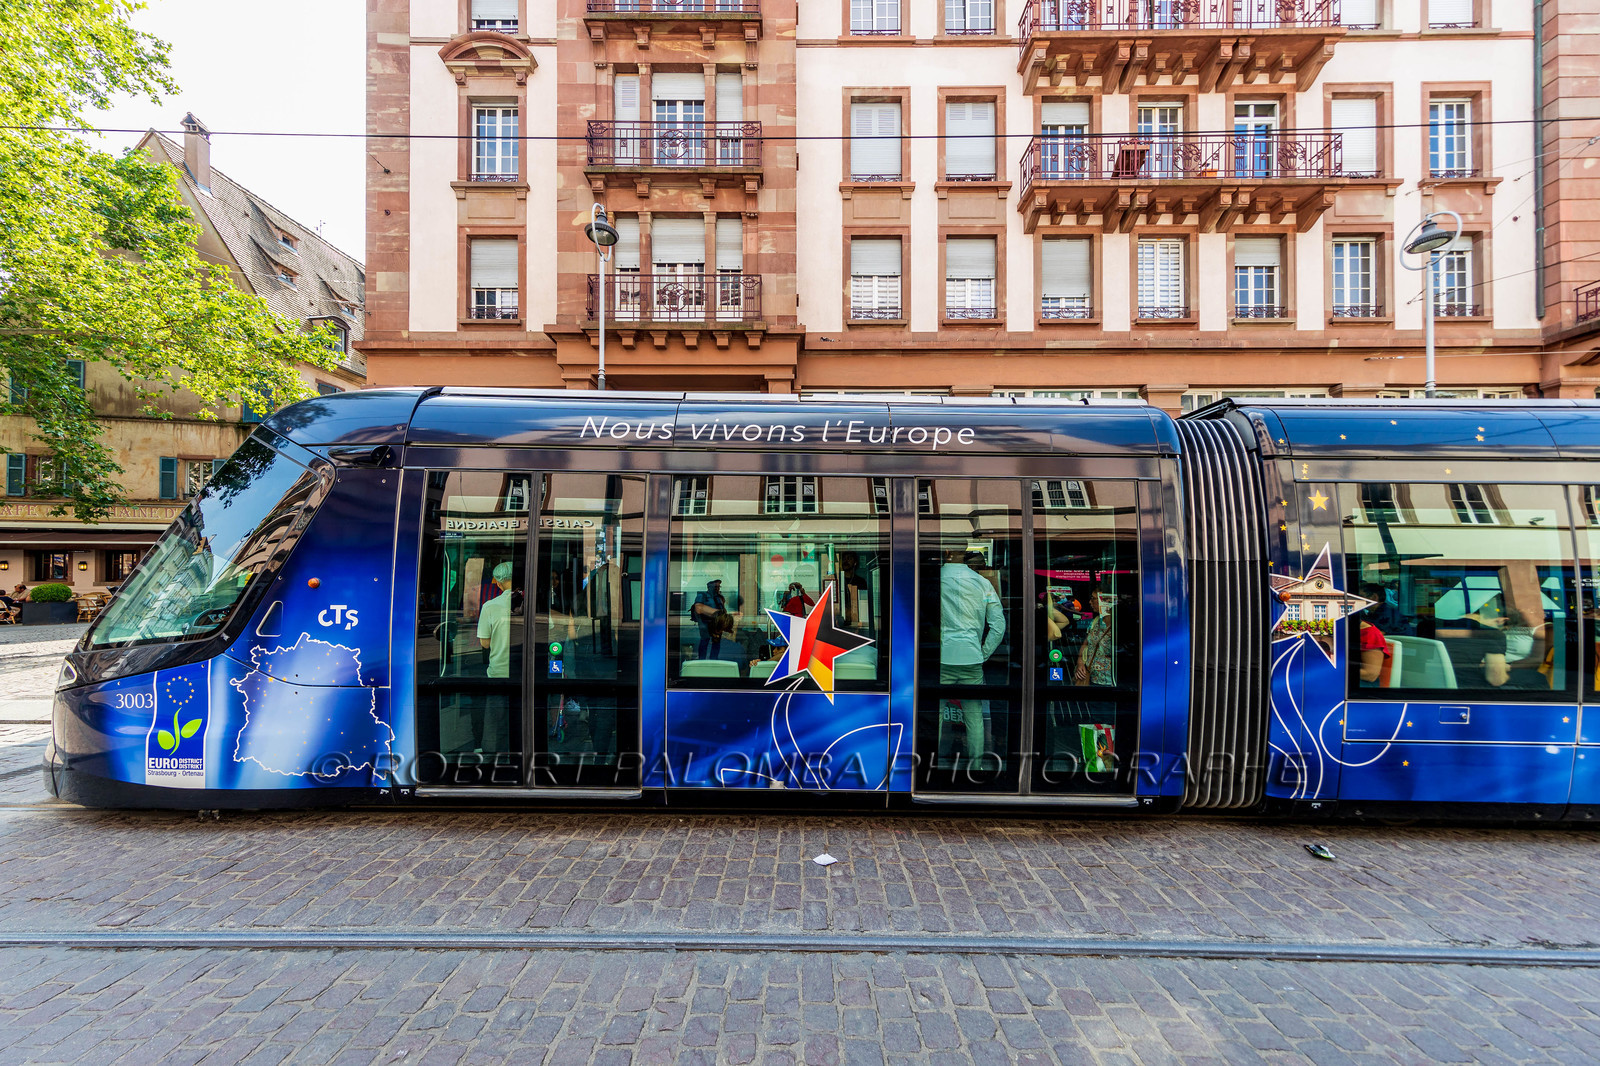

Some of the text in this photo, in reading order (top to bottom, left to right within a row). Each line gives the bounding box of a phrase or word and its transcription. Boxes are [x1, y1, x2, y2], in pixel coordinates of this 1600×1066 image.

[579, 416, 976, 451] Nous vivons l'Europe
[115, 692, 154, 709] 3003
[148, 757, 179, 769] EURO
[147, 769, 177, 777] Strasbourg
